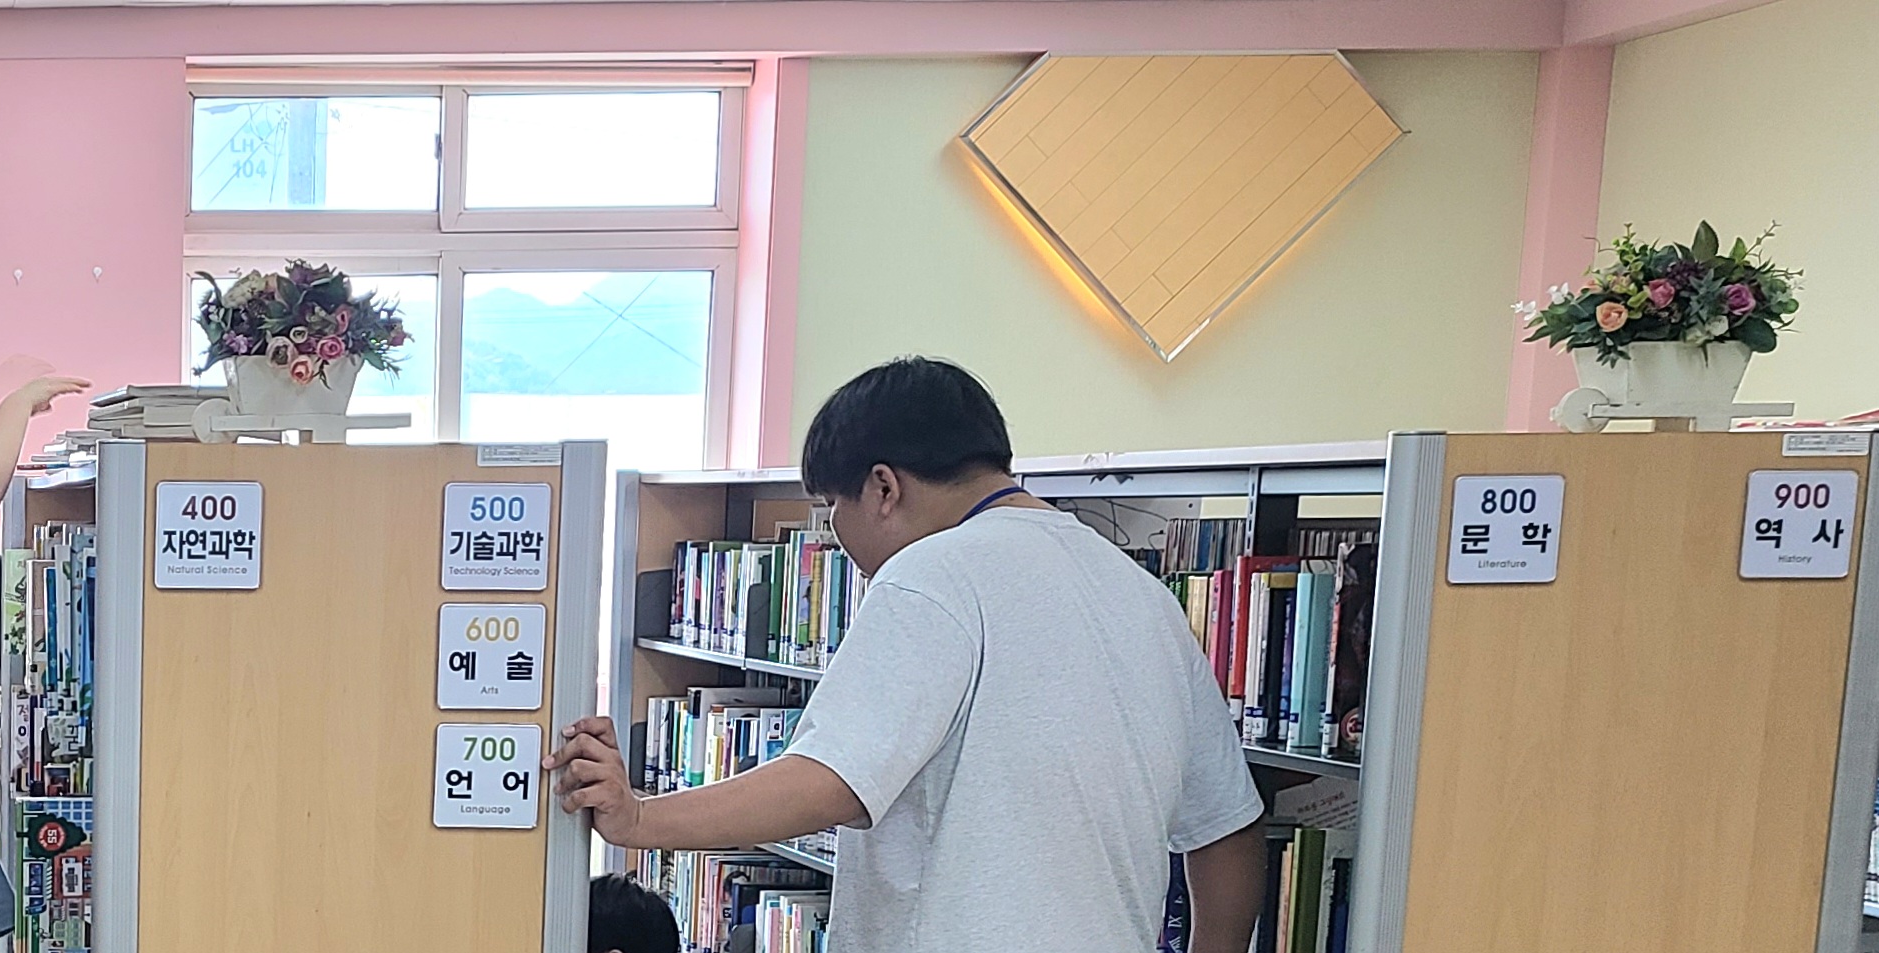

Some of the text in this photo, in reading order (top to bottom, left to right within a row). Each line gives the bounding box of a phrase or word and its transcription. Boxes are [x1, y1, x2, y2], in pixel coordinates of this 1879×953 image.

[230, 138, 254, 153] LH
[232, 159, 267, 179] 104
[182, 496, 236, 520] 400
[1481, 489, 1536, 514] 800
[1775, 484, 1830, 509] 900
[471, 497, 524, 521] 500
[163, 530, 255, 560] 자연과학
[1461, 523, 1551, 554] 문 학
[1755, 519, 1844, 548] 역 사
[450, 531, 543, 561] 기술과학
[167, 565, 248, 575] Natural Science
[448, 566, 540, 576] Technology Science
[1477, 560, 1527, 569] Literature
[1778, 555, 1813, 567] History
[466, 617, 519, 641] 600
[449, 652, 533, 680] 예 술
[480, 686, 500, 695] Arts
[464, 738, 515, 761] 700
[446, 770, 529, 800] 언 어
[460, 804, 511, 816] Language
